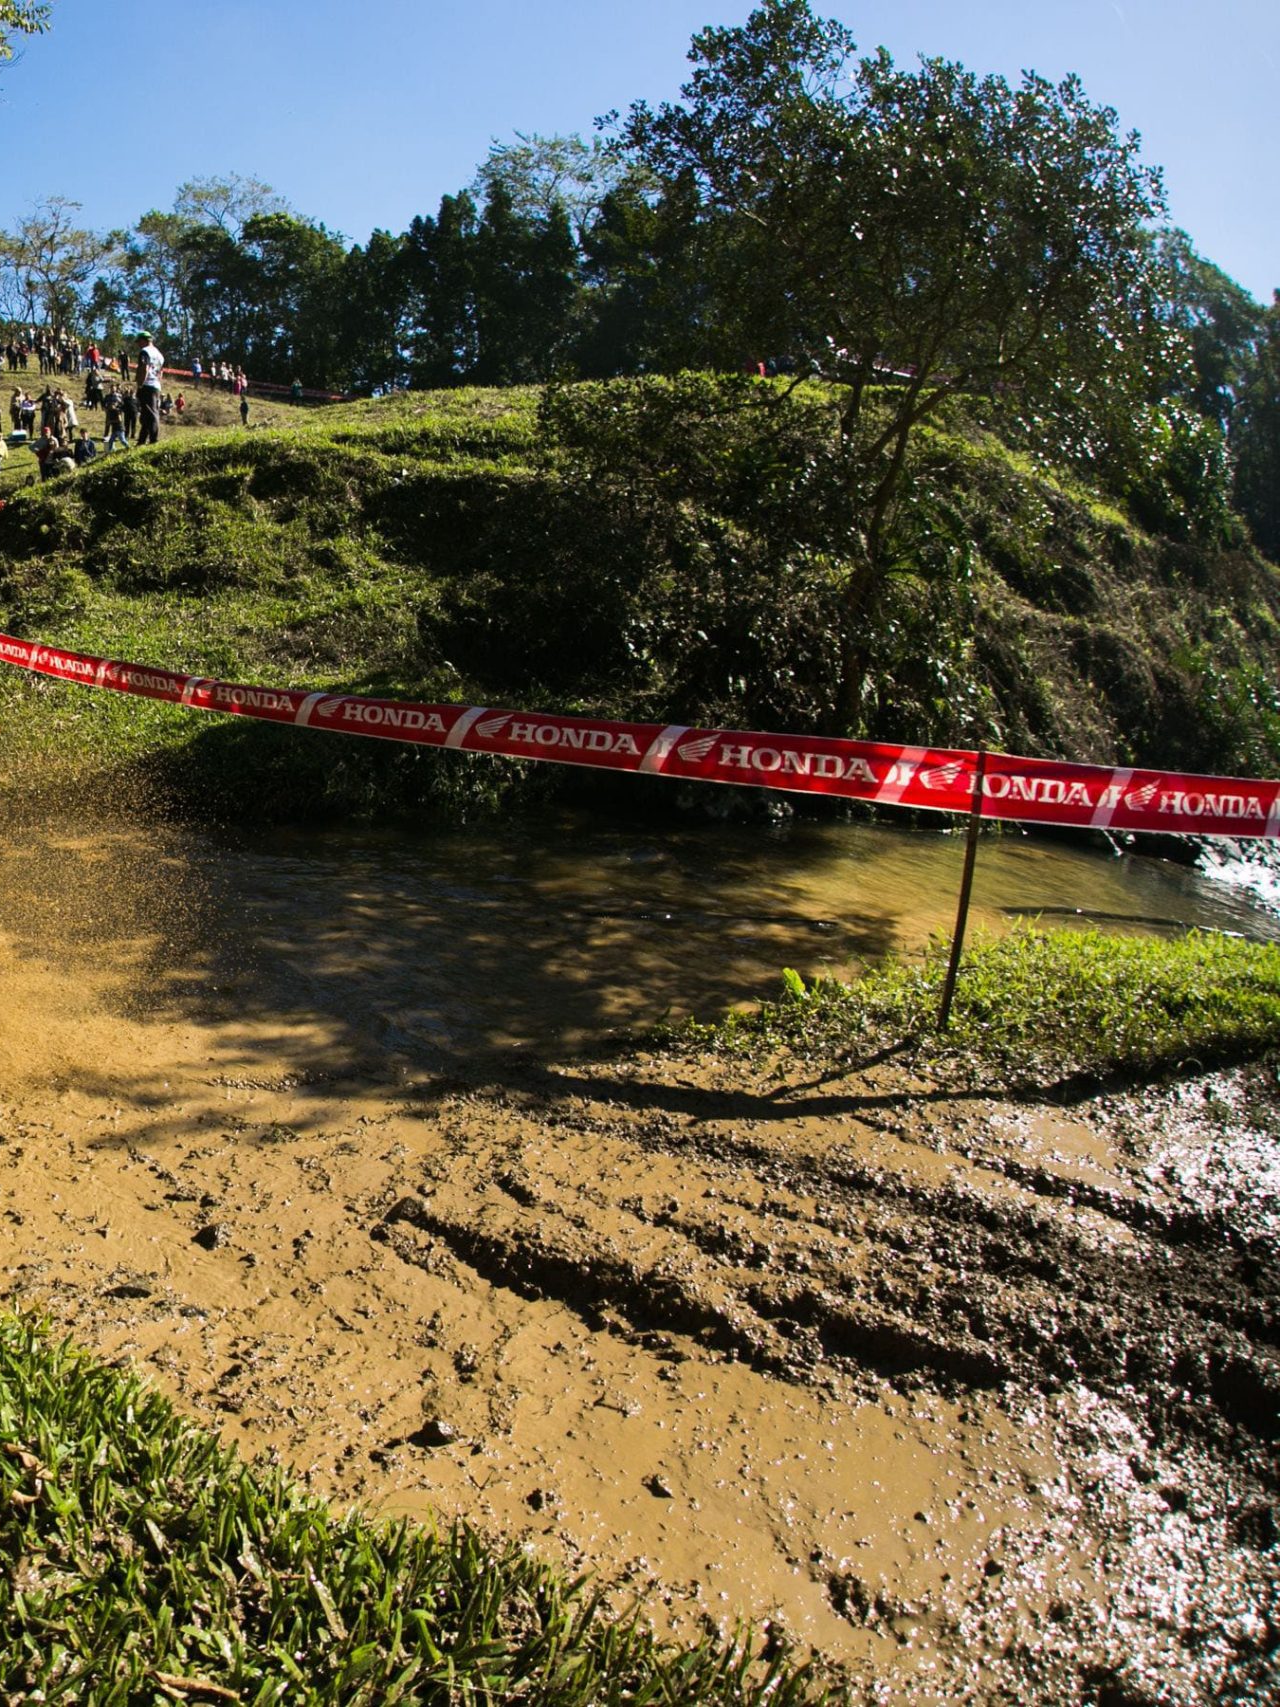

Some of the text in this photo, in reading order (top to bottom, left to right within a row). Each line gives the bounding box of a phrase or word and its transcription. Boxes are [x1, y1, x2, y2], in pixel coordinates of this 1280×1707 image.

[120, 670, 182, 694] HONDA
[216, 687, 296, 713] HONDA
[342, 703, 447, 733] HONDA
[508, 722, 641, 756] HONDA
[718, 743, 879, 784] HONDA
[1158, 791, 1266, 820] HONDA
